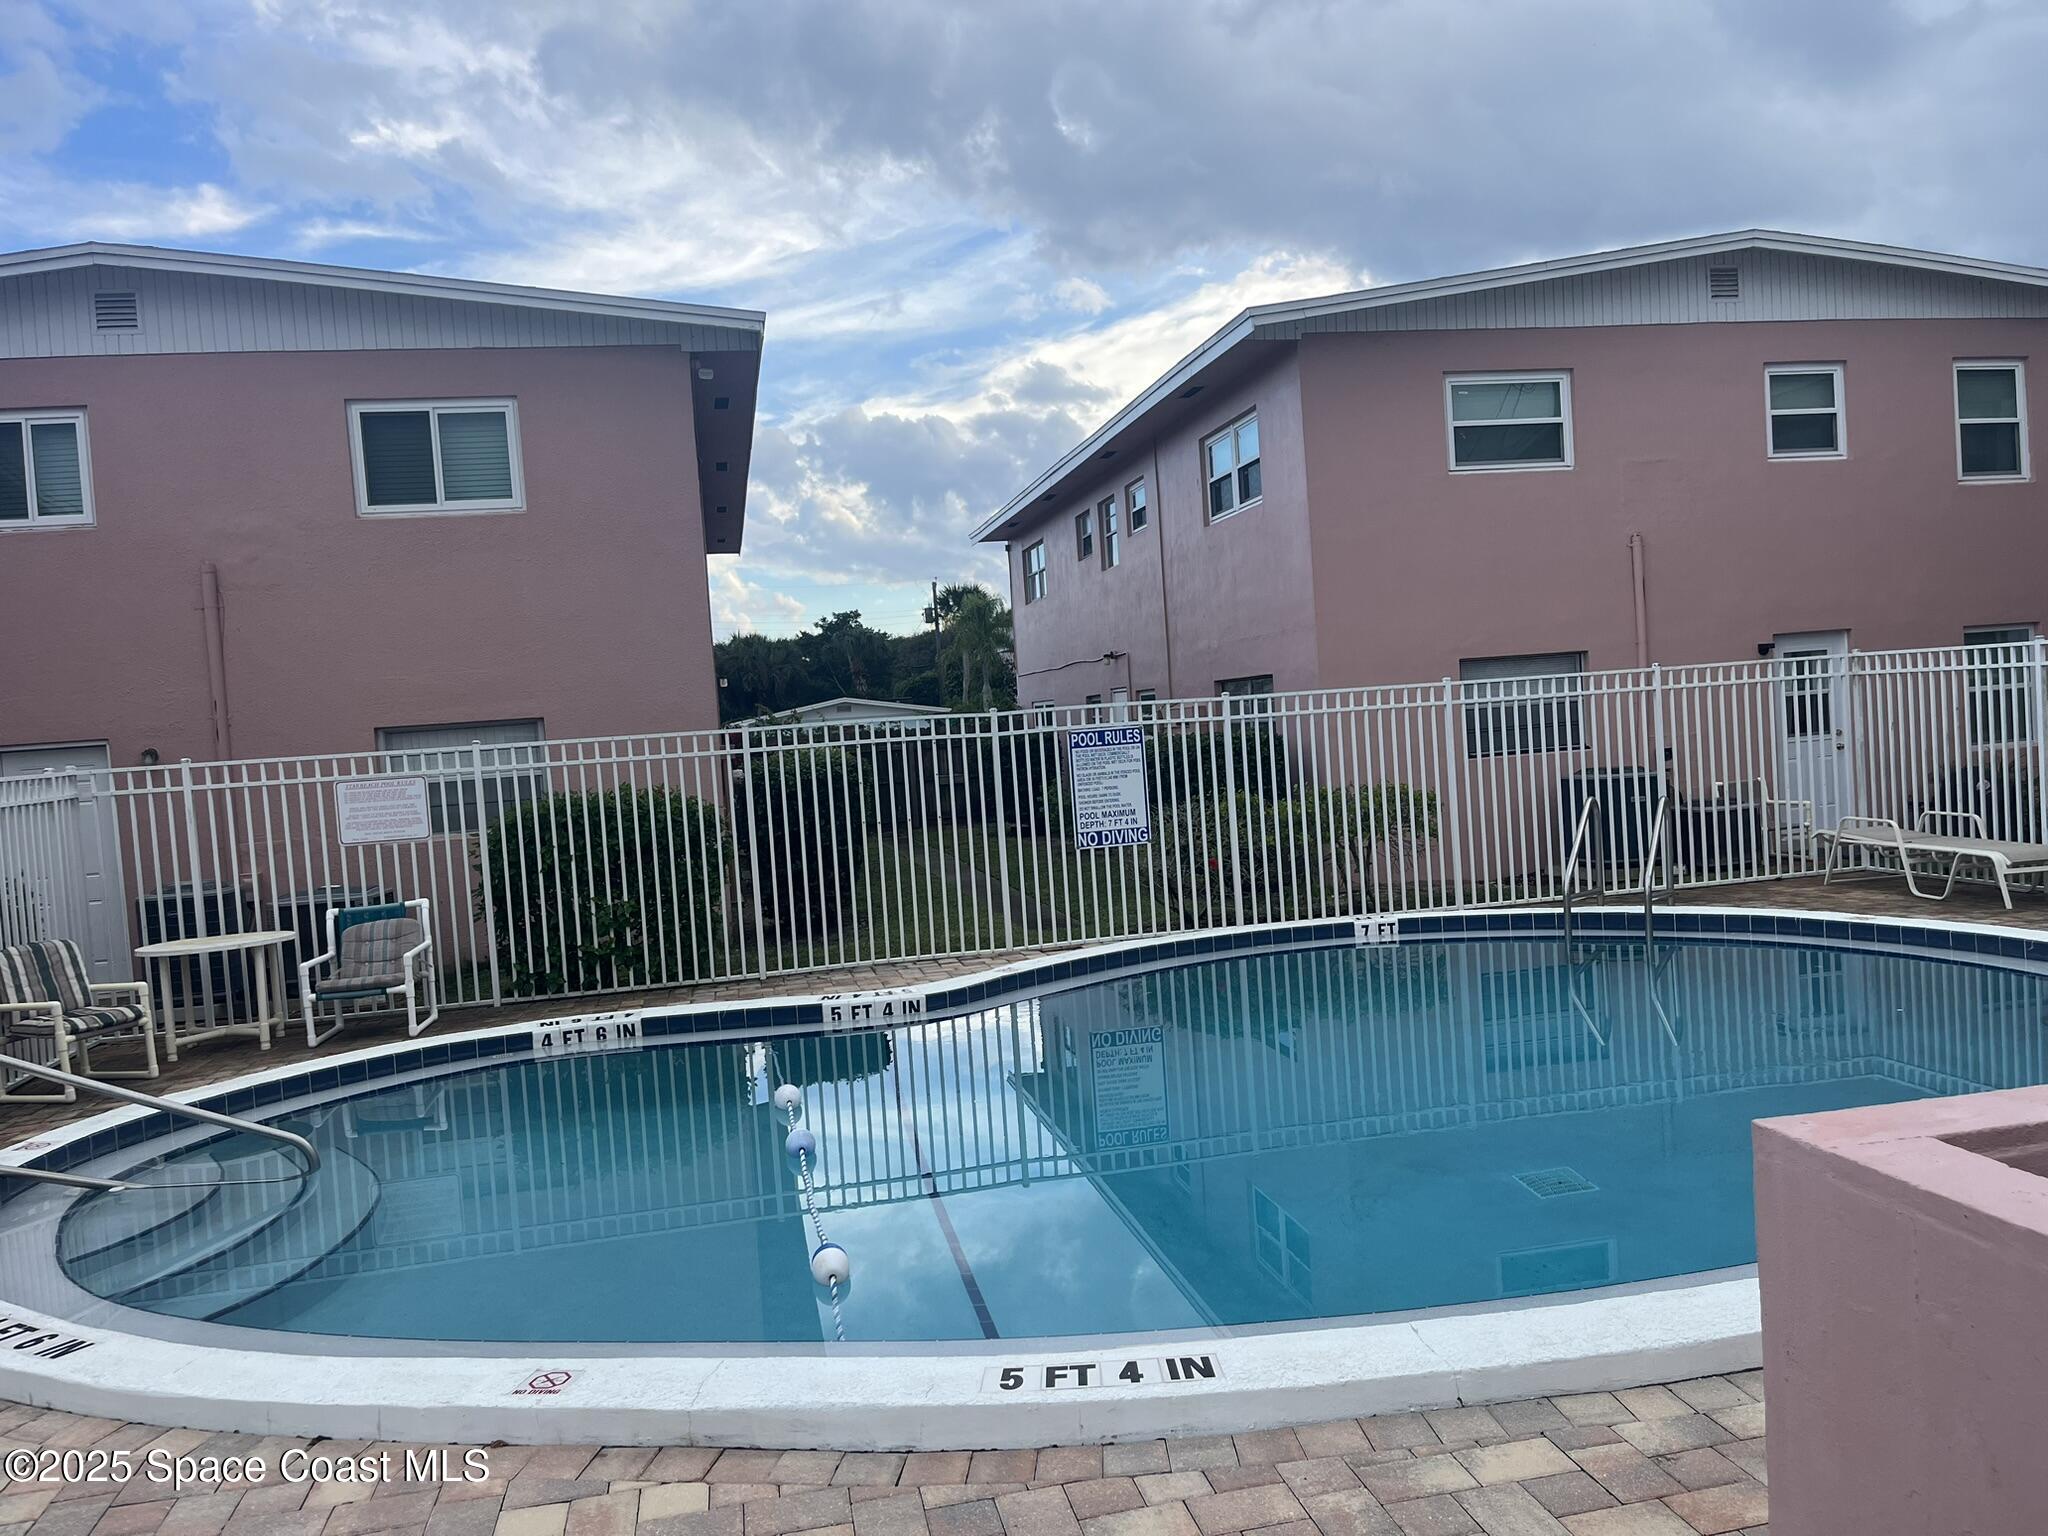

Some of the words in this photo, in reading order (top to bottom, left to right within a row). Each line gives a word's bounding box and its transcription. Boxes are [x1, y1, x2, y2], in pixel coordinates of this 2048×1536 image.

[1071, 732, 1102, 747] POOL
[1104, 729, 1141, 745] RULES
[1080, 812, 1099, 820] POOL
[1101, 808, 1136, 818] MAXIMUM
[1080, 821, 1107, 830] DEPTH:
[1114, 818, 1123, 826] FT
[1125, 818, 1129, 826] 4
[1130, 817, 1138, 825] IN
[1078, 831, 1099, 847] NO
[1101, 827, 1148, 845] DIVING
[1361, 924, 1369, 936] 7
[1378, 922, 1395, 935] FT
[831, 1006, 841, 1021] 5
[851, 1004, 872, 1020] FT
[882, 1002, 894, 1016] 4
[902, 999, 920, 1014] IN
[541, 1033, 553, 1047] 4
[562, 1028, 585, 1044] FT
[595, 1026, 607, 1040] 6
[616, 1023, 636, 1038] IN
[13, 1333, 60, 1350] 6
[33, 1338, 96, 1359] IN
[999, 1367, 1024, 1390] 5
[1045, 1363, 1096, 1388] FT
[1118, 1360, 1144, 1383] 4
[1165, 1356, 1217, 1380] IN
